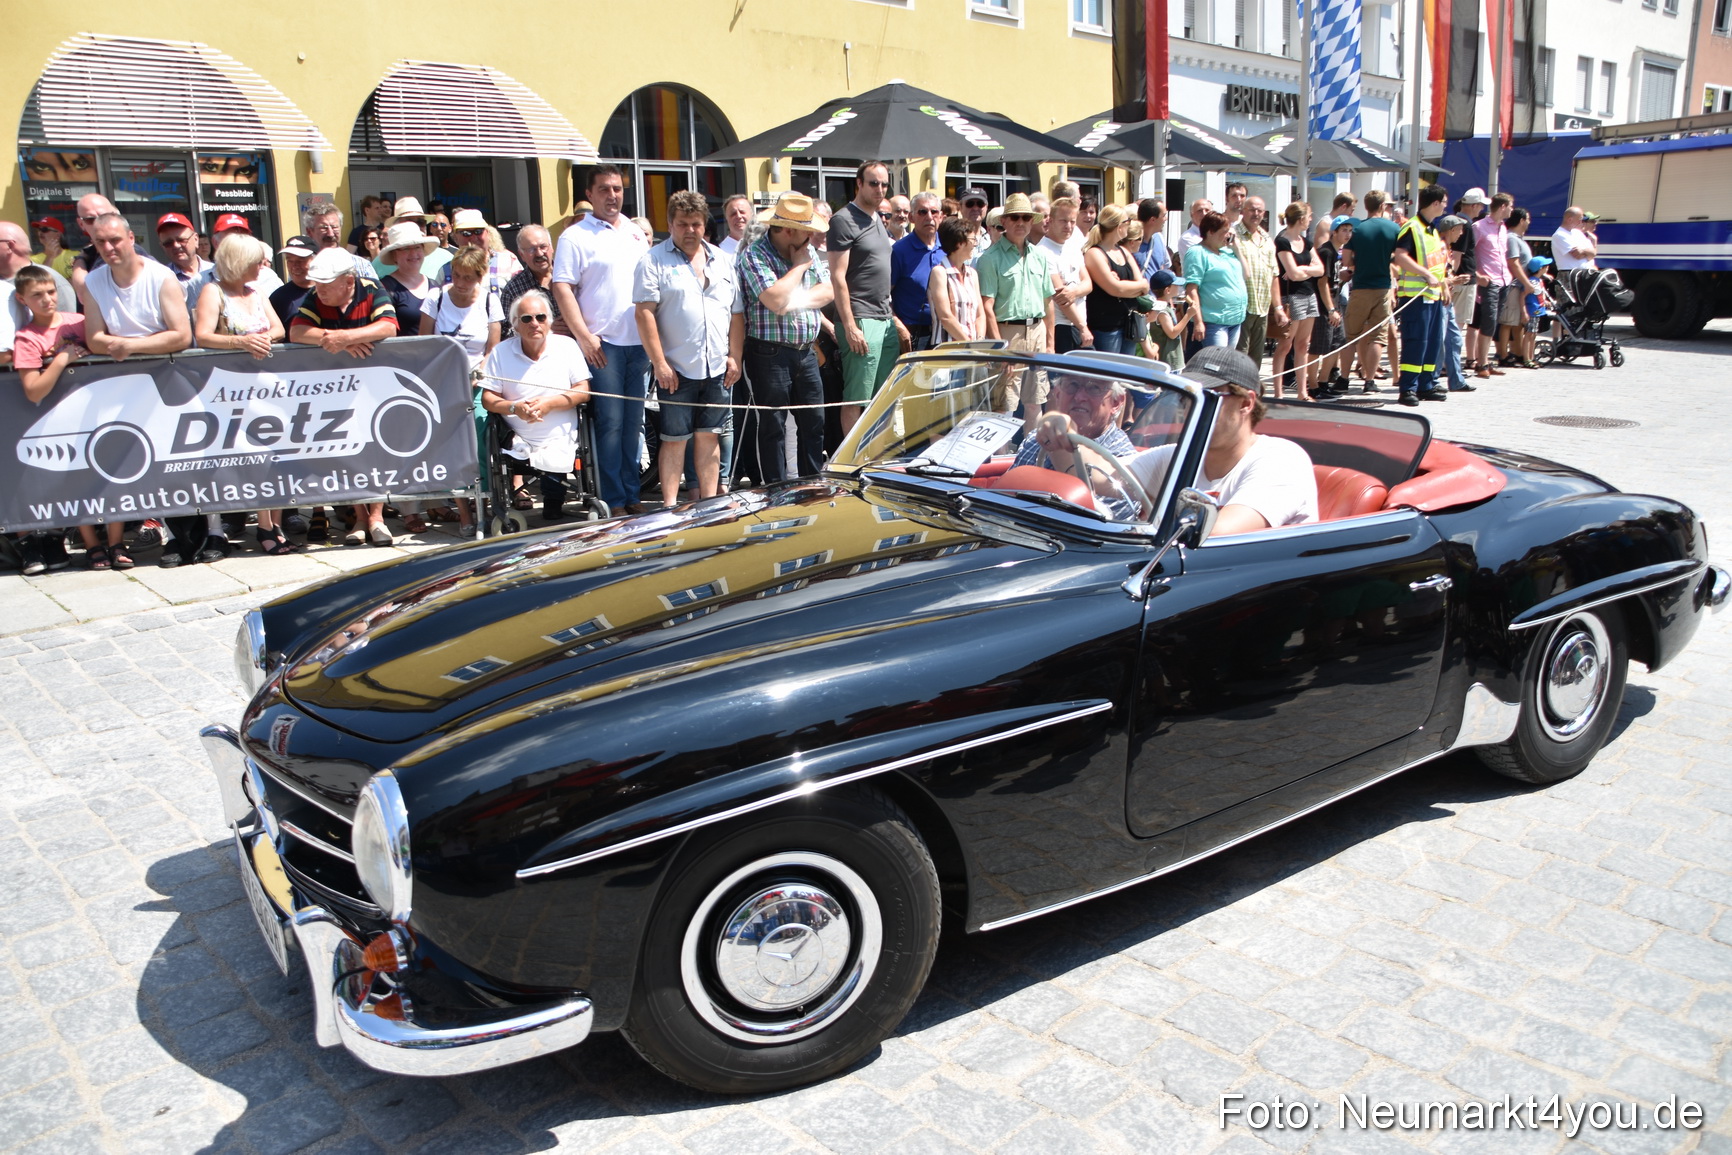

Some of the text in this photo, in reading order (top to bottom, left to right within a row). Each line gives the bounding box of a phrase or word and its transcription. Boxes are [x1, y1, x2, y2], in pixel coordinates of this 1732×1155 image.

[29, 187, 63, 197] Digitale
[215, 189, 254, 198] Passbilder
[1116, 180, 1126, 192] 24
[203, 203, 269, 214] Bewerbungsbilder
[210, 374, 361, 404] Autoklassik
[170, 401, 355, 455] Dietz
[967, 425, 998, 444] 204
[163, 454, 268, 474] BREITENBRUNN
[29, 461, 448, 521] www.autoklassik-dietz.de
